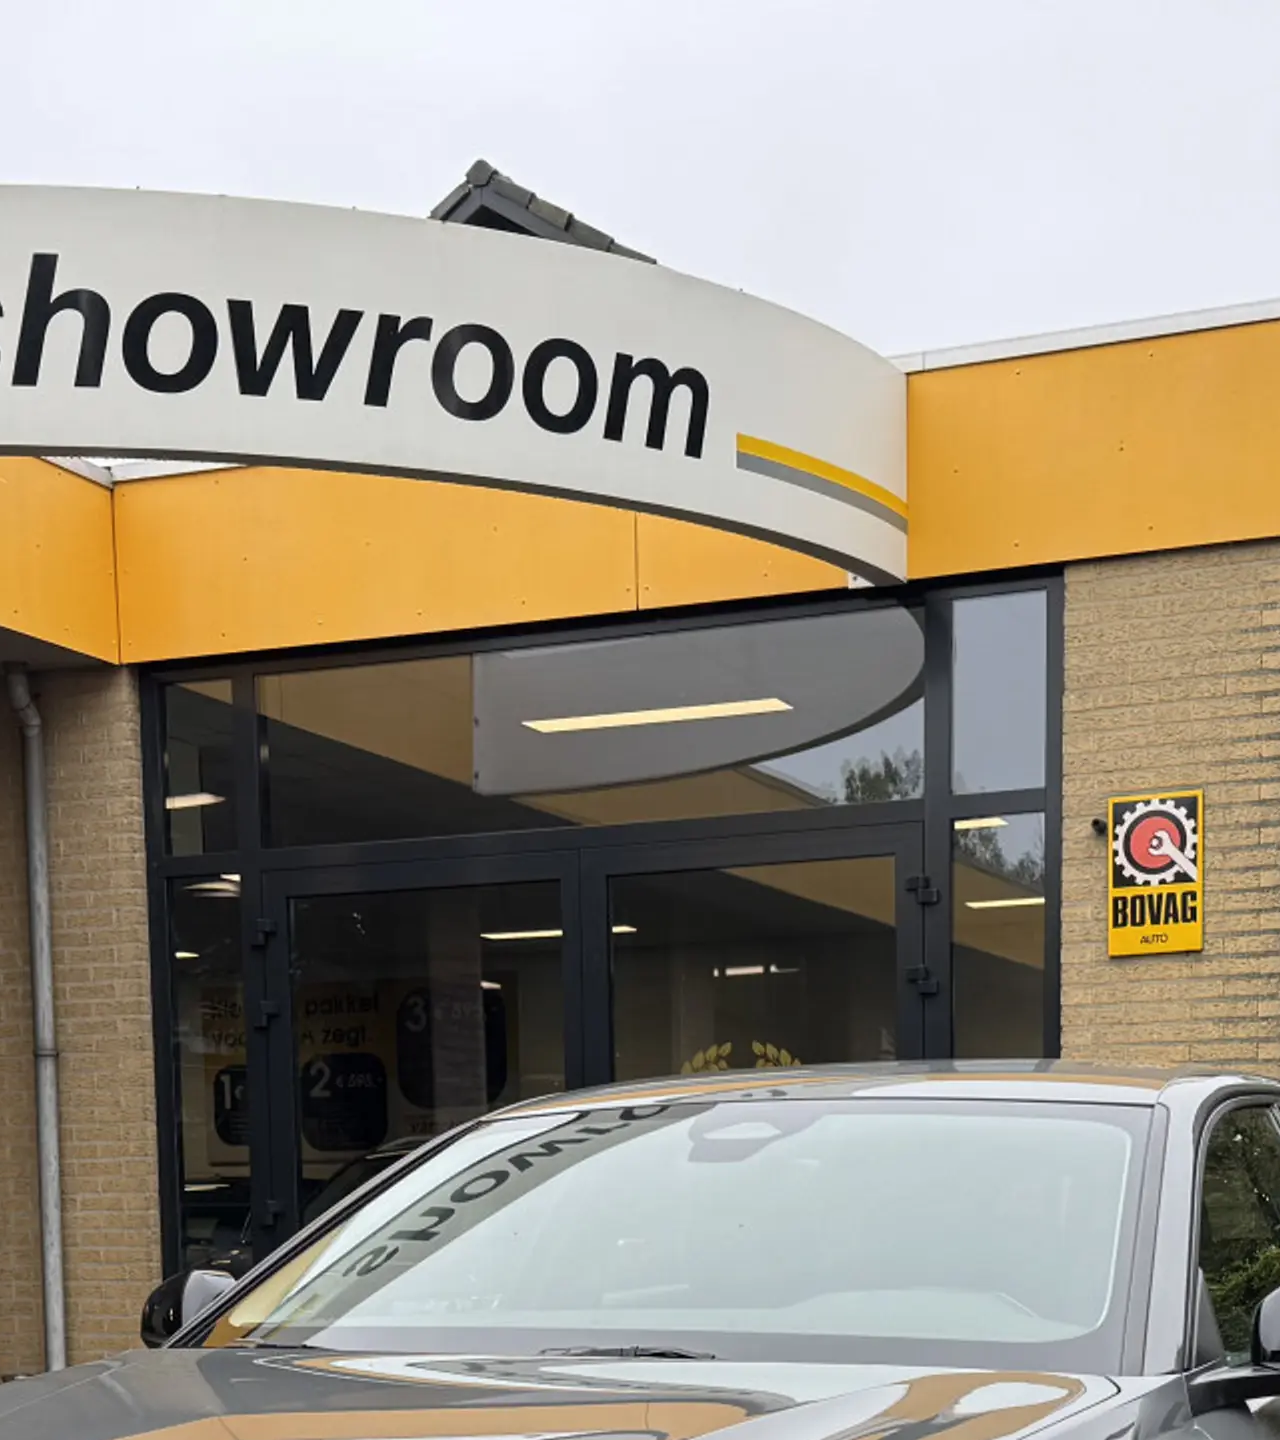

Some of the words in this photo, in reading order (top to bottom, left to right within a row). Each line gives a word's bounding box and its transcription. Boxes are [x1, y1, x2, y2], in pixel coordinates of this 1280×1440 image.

[1112, 890, 1198, 929] BOVAG
[1139, 933, 1169, 945] AUTO
[308, 1060, 332, 1098] 2
